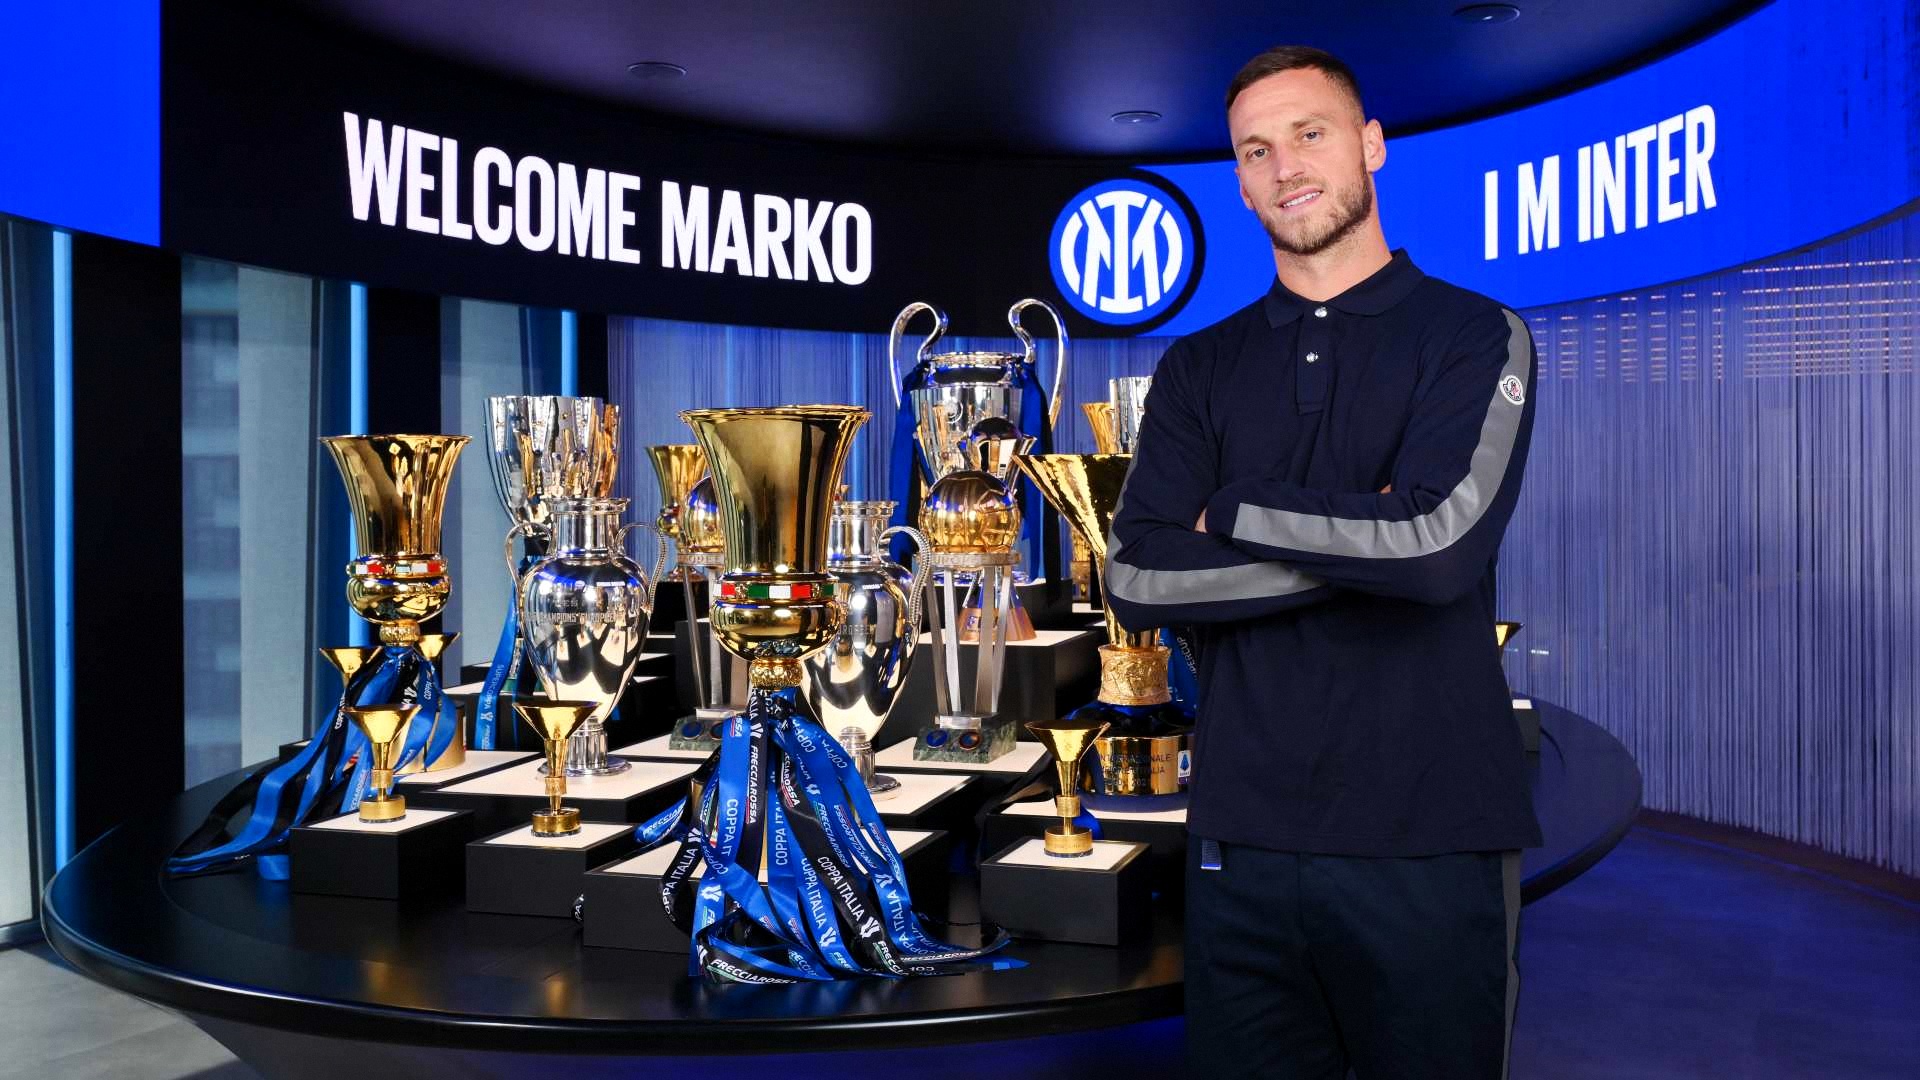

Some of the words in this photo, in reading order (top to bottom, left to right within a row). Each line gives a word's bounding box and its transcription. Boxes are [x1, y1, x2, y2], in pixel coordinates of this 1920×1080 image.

[343, 111, 641, 264] WELCOME
[661, 180, 872, 286] MARKO
[1484, 170, 1499, 260] I
[1518, 155, 1561, 255] M
[1578, 103, 1717, 241] INTER
[749, 744, 759, 824] FRECCIAROSSA
[724, 798, 739, 845] COPPA
[671, 848, 697, 884] ITALIA
[775, 828, 788, 866] COPPA
[809, 887, 827, 929] ITALIA
[817, 856, 842, 885] COPPA
[836, 881, 866, 922] ITALIA
[886, 889, 905, 932] ITALIA
